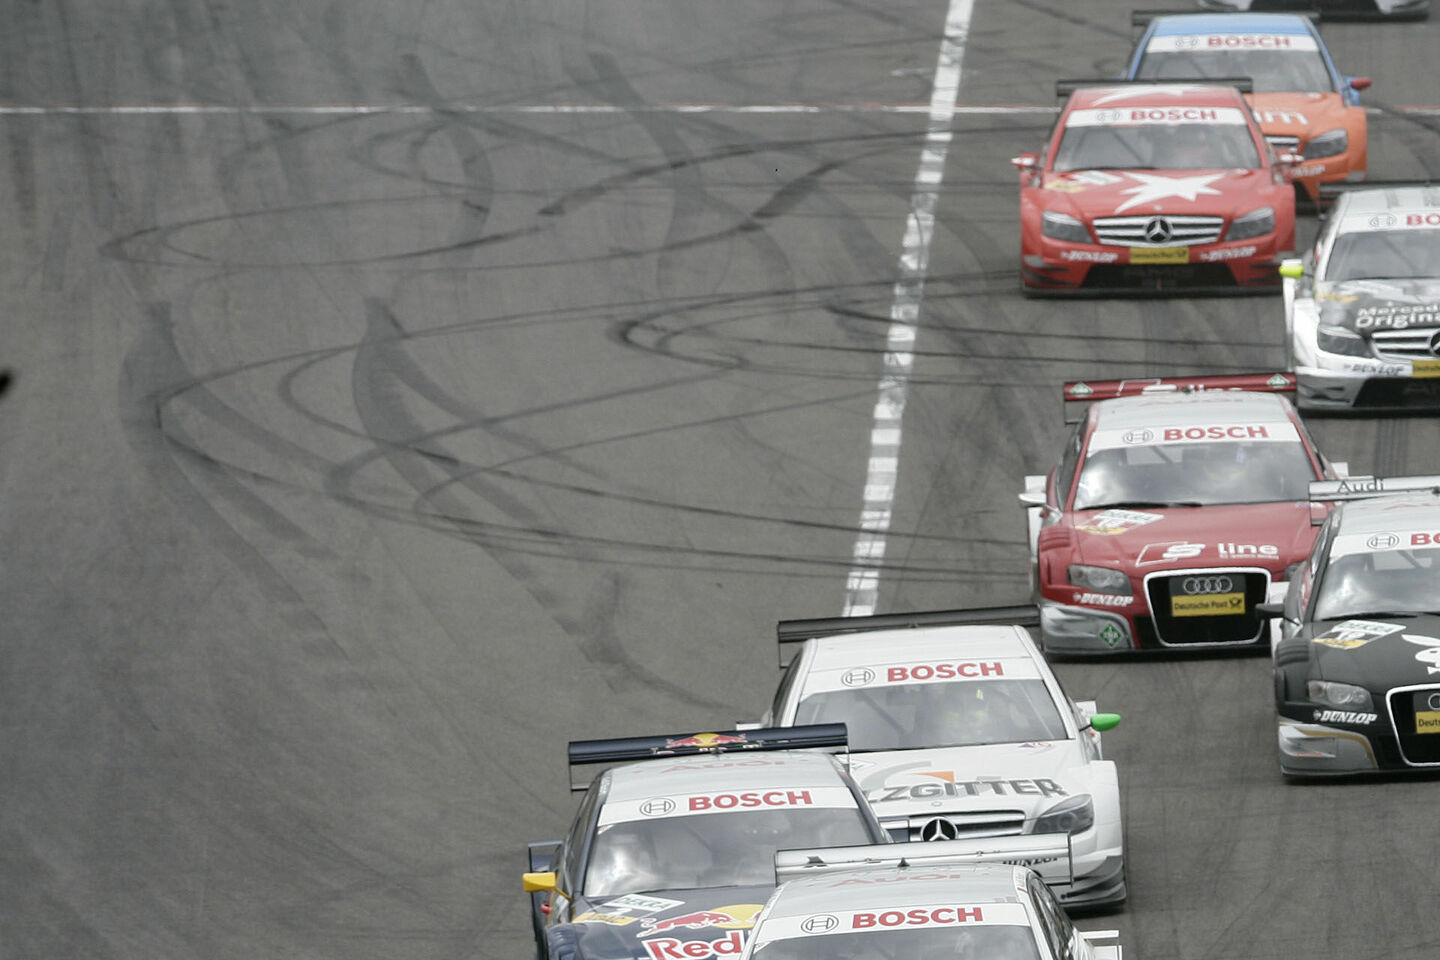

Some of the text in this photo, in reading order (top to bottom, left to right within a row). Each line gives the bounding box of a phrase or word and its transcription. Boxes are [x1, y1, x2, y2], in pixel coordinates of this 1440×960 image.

[1207, 35, 1292, 47] BOSCH
[1130, 109, 1217, 121] BOSCH
[1163, 425, 1269, 441] BOSCH
[1336, 478, 1386, 494] Audi
[1217, 542, 1279, 555] line
[1080, 592, 1134, 608] DUNLOP
[887, 662, 1004, 683] BOSCH
[1320, 710, 1378, 725] DUNLOP
[688, 790, 813, 812] BOSCH
[852, 906, 983, 930] BOSCH
